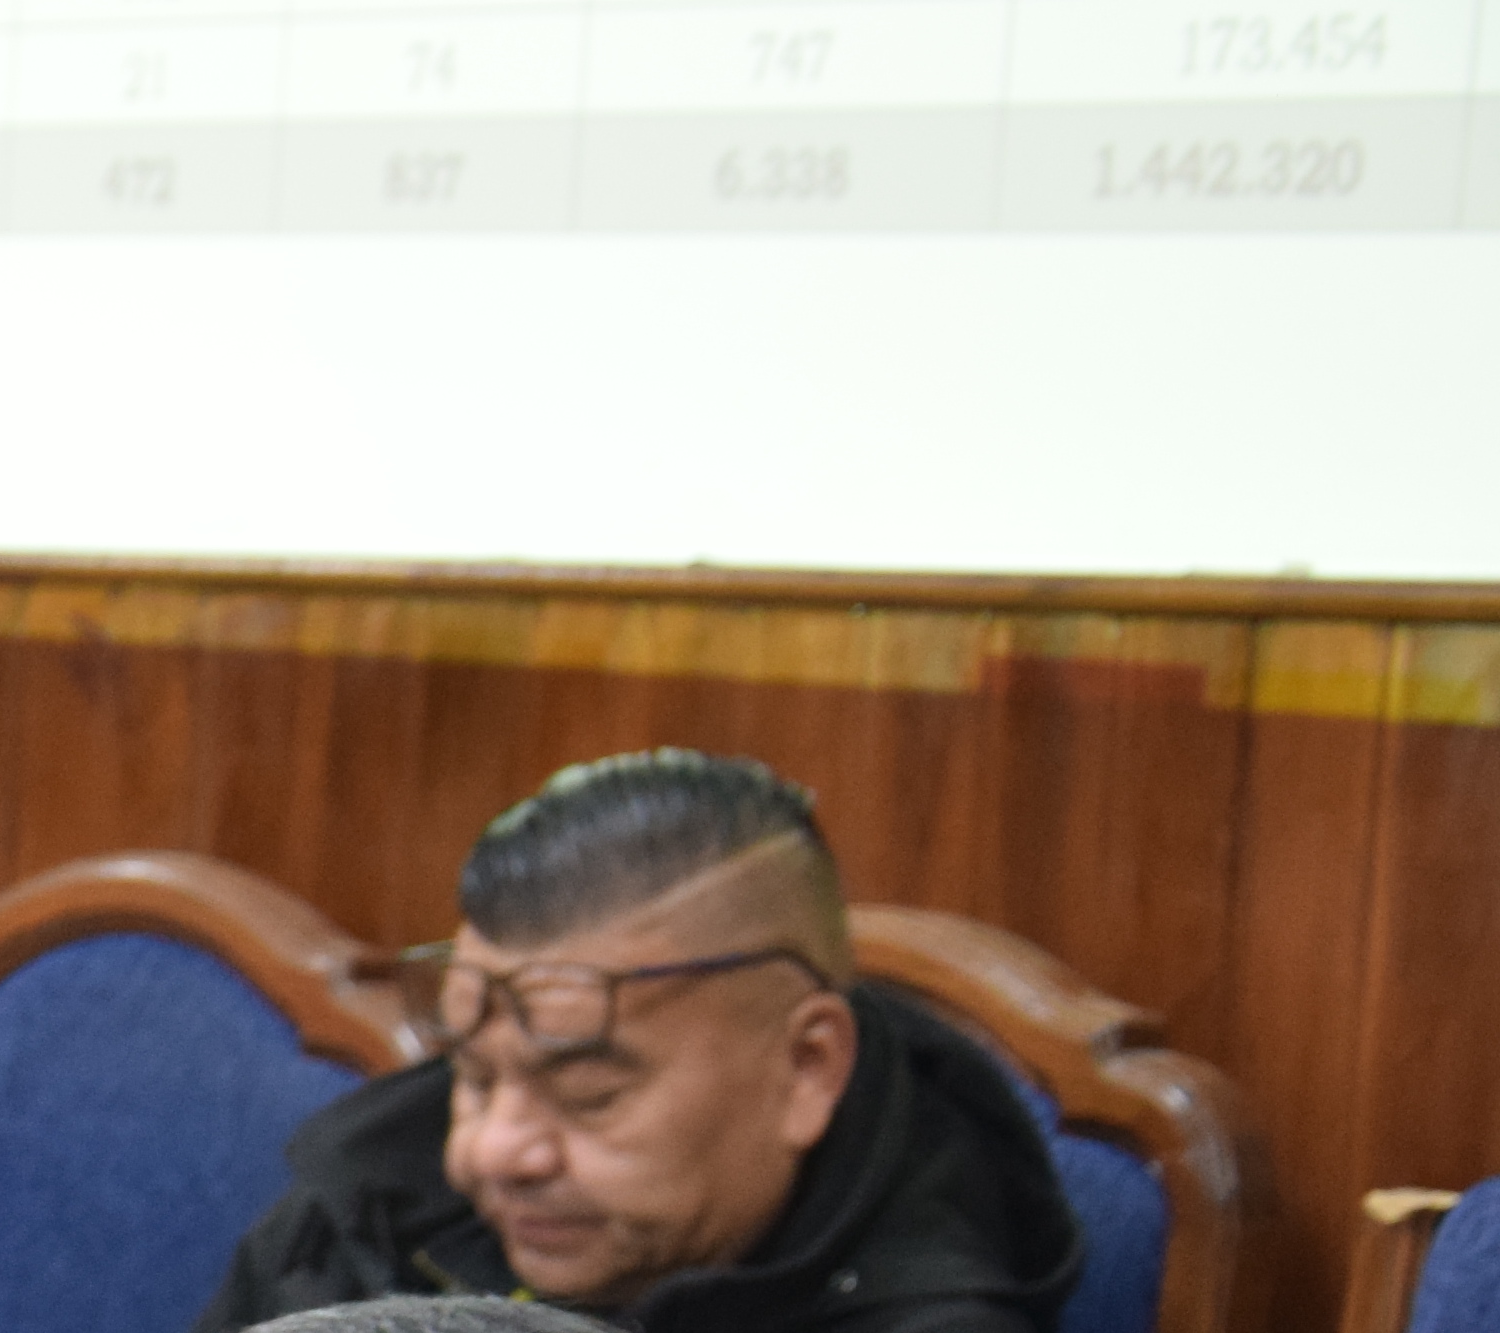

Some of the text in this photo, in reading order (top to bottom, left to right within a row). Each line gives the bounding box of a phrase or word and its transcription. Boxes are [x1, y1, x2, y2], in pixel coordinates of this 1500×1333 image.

[406, 38, 457, 94] 74
[747, 28, 836, 84] 747
[1178, 10, 1388, 75] 173.454
[101, 152, 177, 208] 472
[383, 148, 466, 203] 837
[713, 143, 850, 203] 6.338
[1094, 137, 1363, 200] 1.442.320
